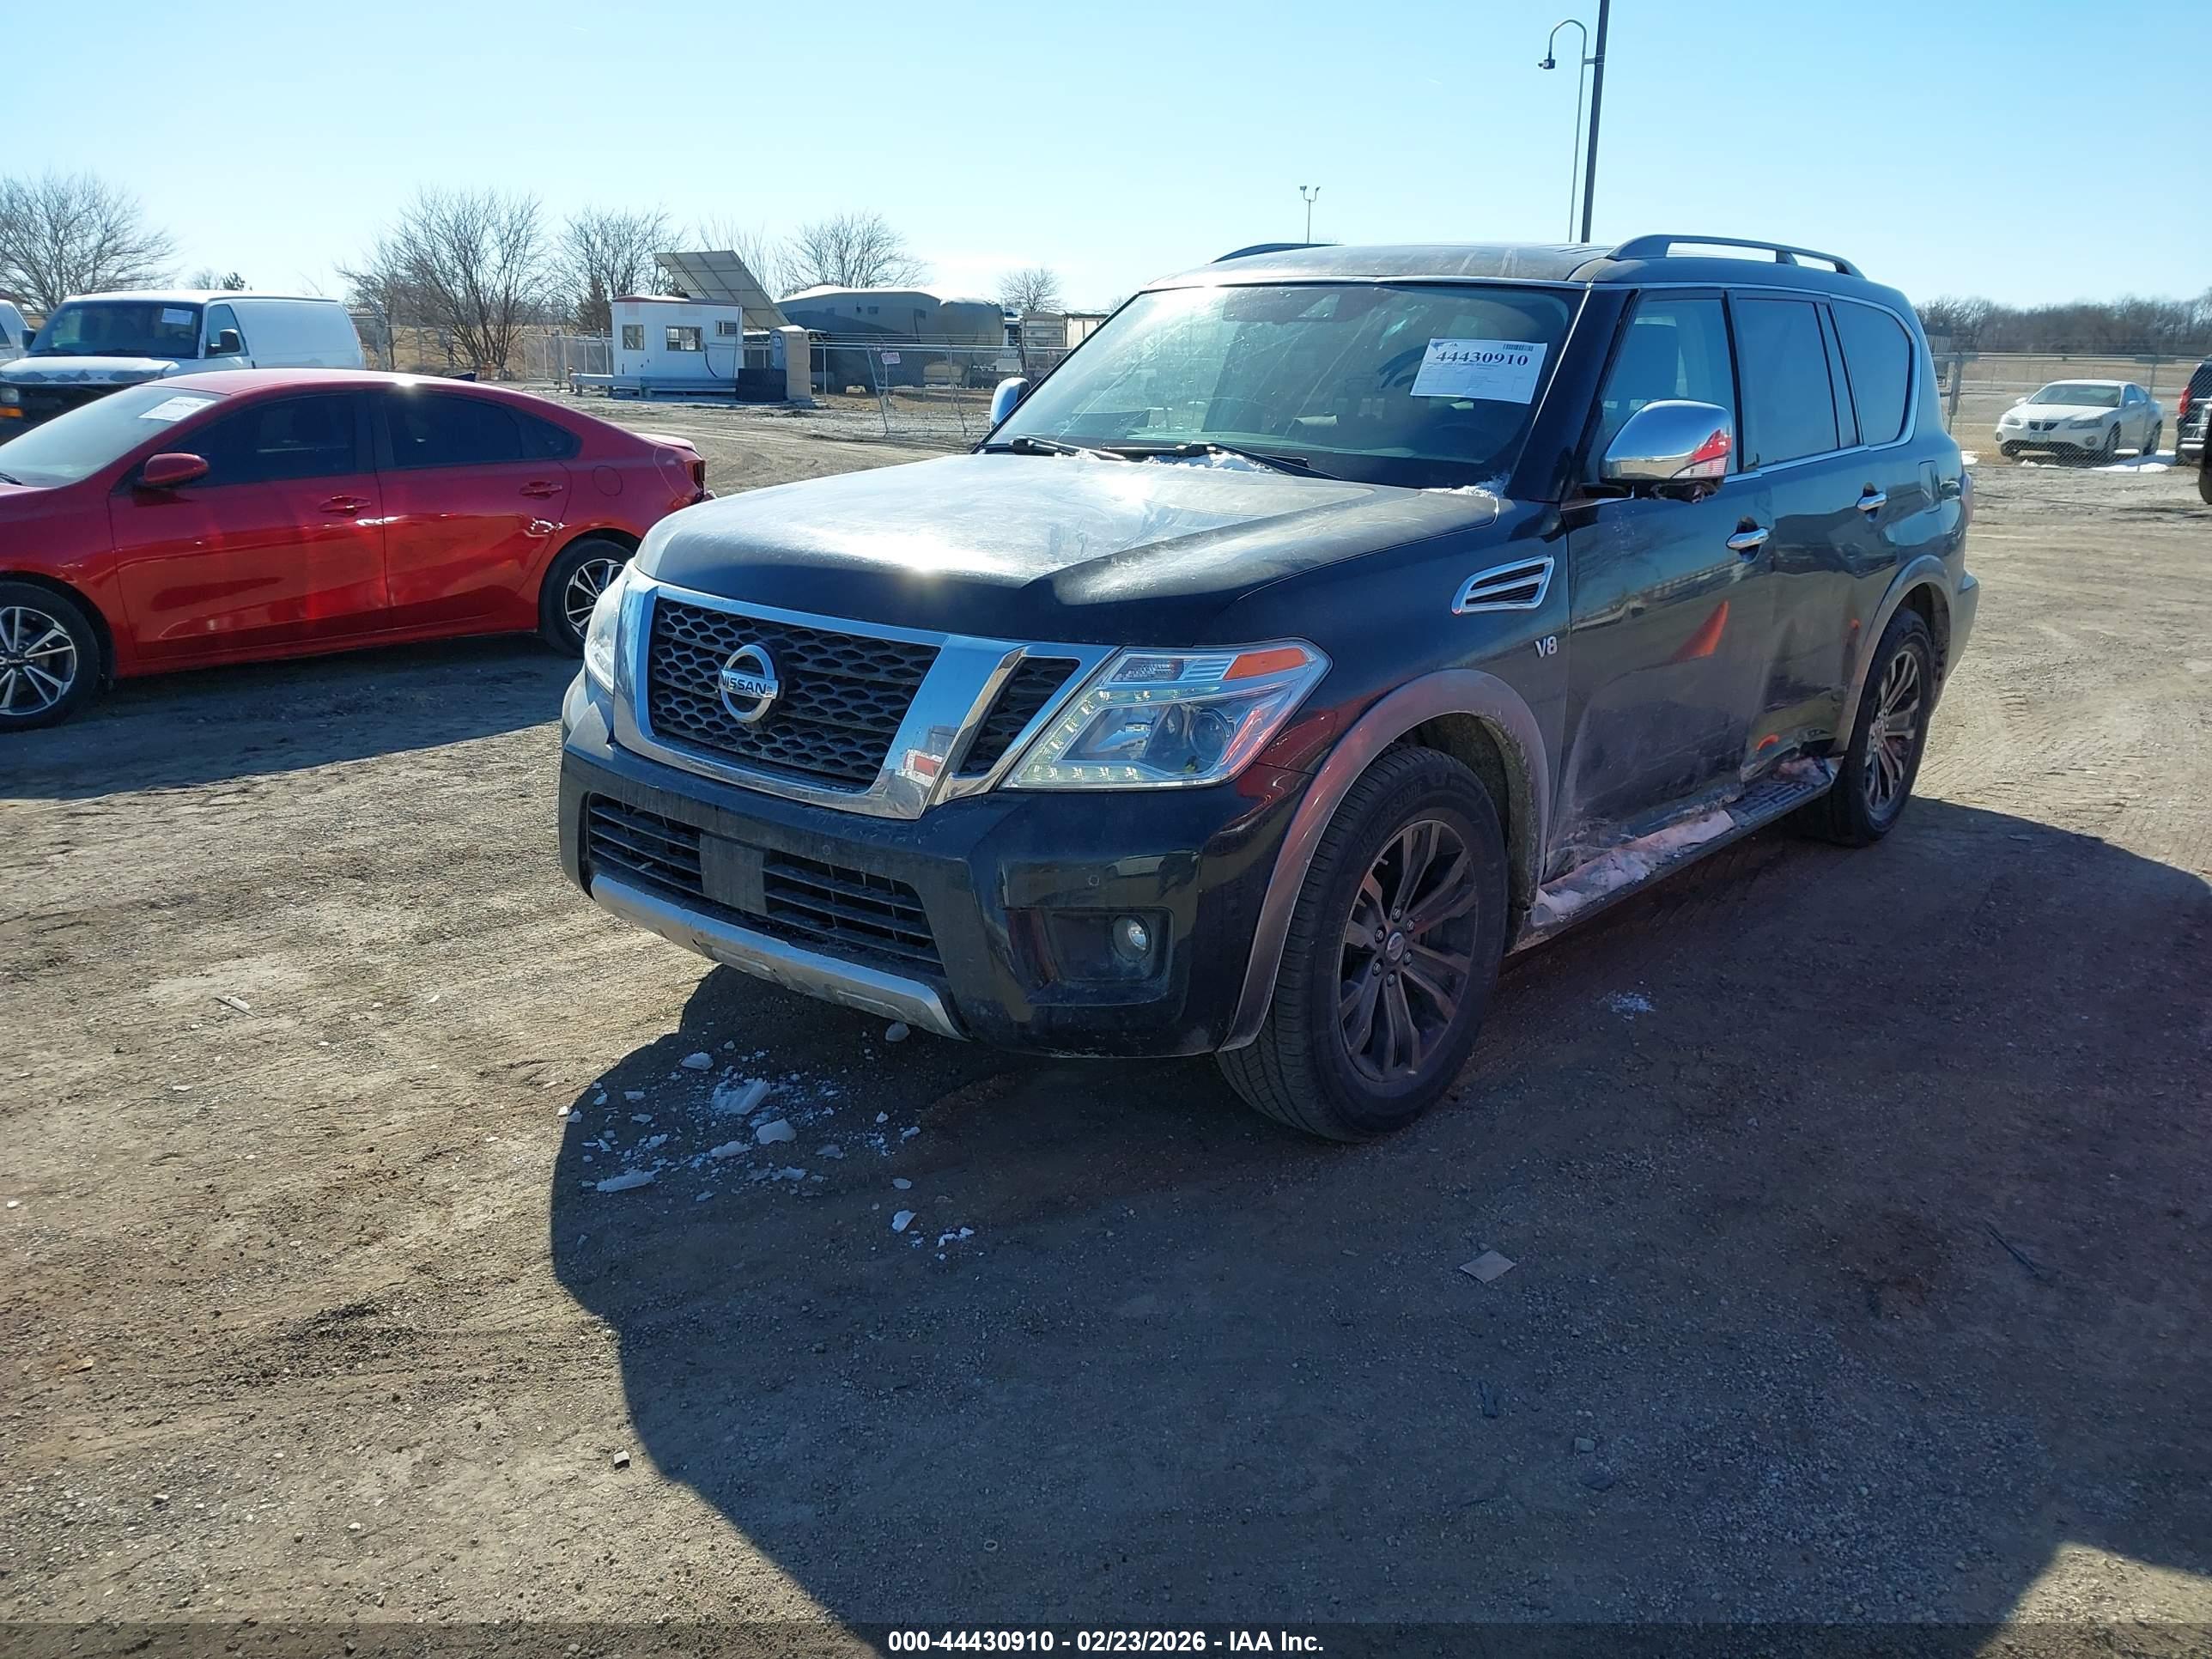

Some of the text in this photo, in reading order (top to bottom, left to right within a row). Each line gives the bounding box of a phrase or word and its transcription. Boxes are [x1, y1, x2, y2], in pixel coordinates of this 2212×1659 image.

[1435, 351, 1528, 367] 44430910
[1534, 635, 1558, 658] V8
[721, 672, 767, 695] NISSAN
